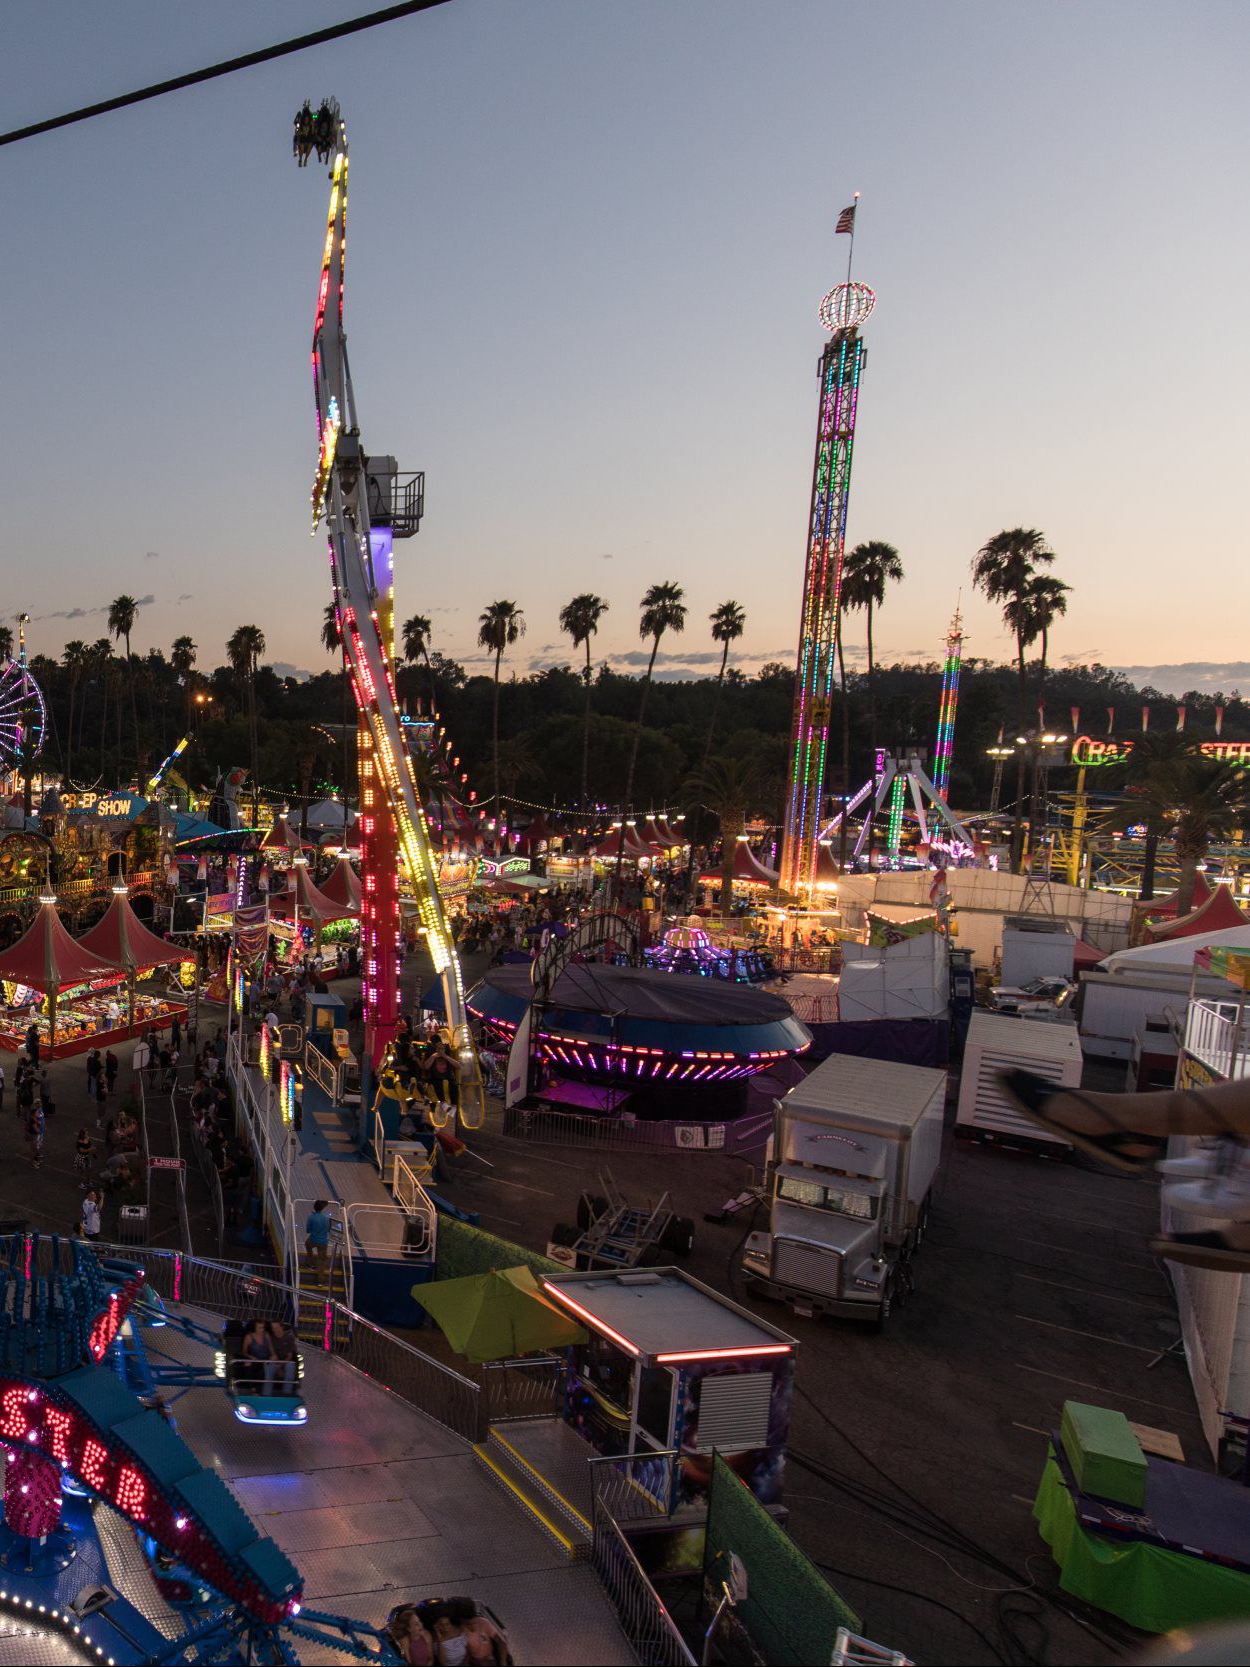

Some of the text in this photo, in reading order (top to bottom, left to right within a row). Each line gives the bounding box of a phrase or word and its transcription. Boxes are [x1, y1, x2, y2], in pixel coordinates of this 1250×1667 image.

[1071, 735, 1135, 766] CRAZ
[60, 793, 132, 816] CREP SHOW
